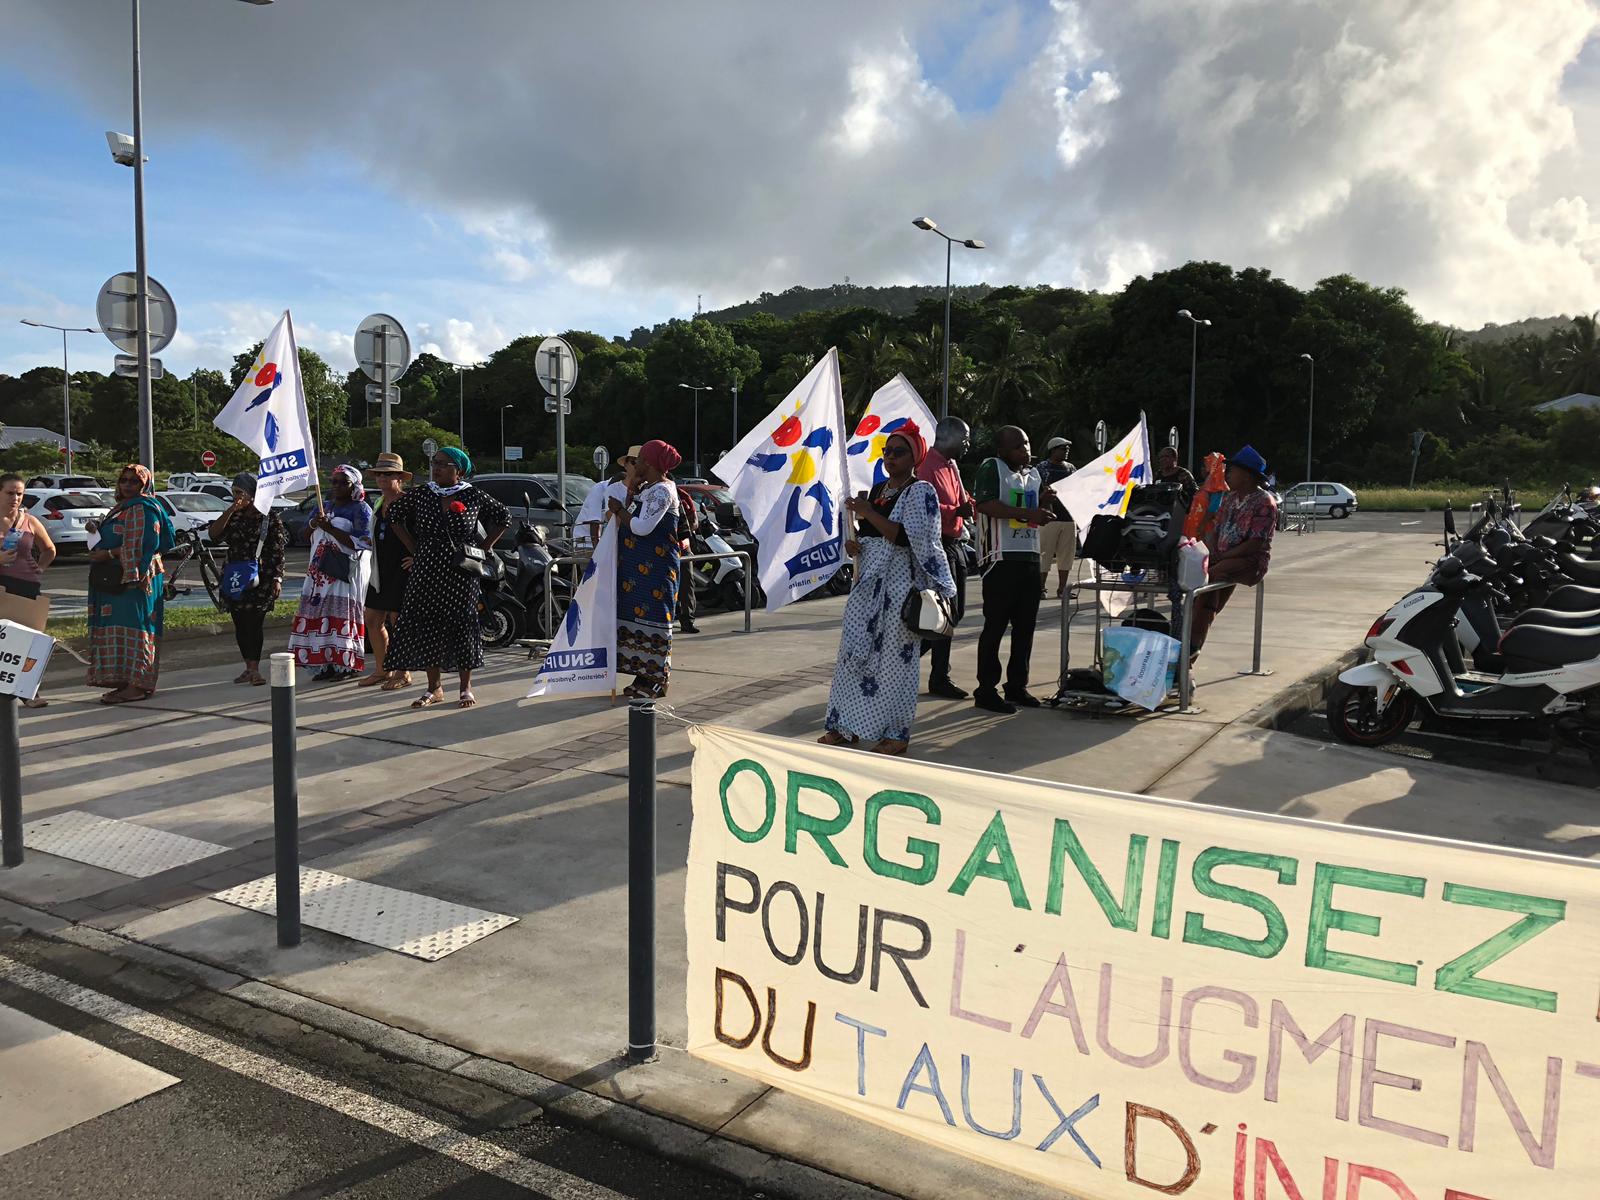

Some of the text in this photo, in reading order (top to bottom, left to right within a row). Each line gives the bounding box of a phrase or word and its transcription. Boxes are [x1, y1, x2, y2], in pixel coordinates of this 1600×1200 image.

[715, 861, 930, 1009] POUR
[719, 758, 1566, 1013] ORGANISEZ
[714, 967, 817, 1071] DU
[834, 1011, 1102, 1169] TAUX
